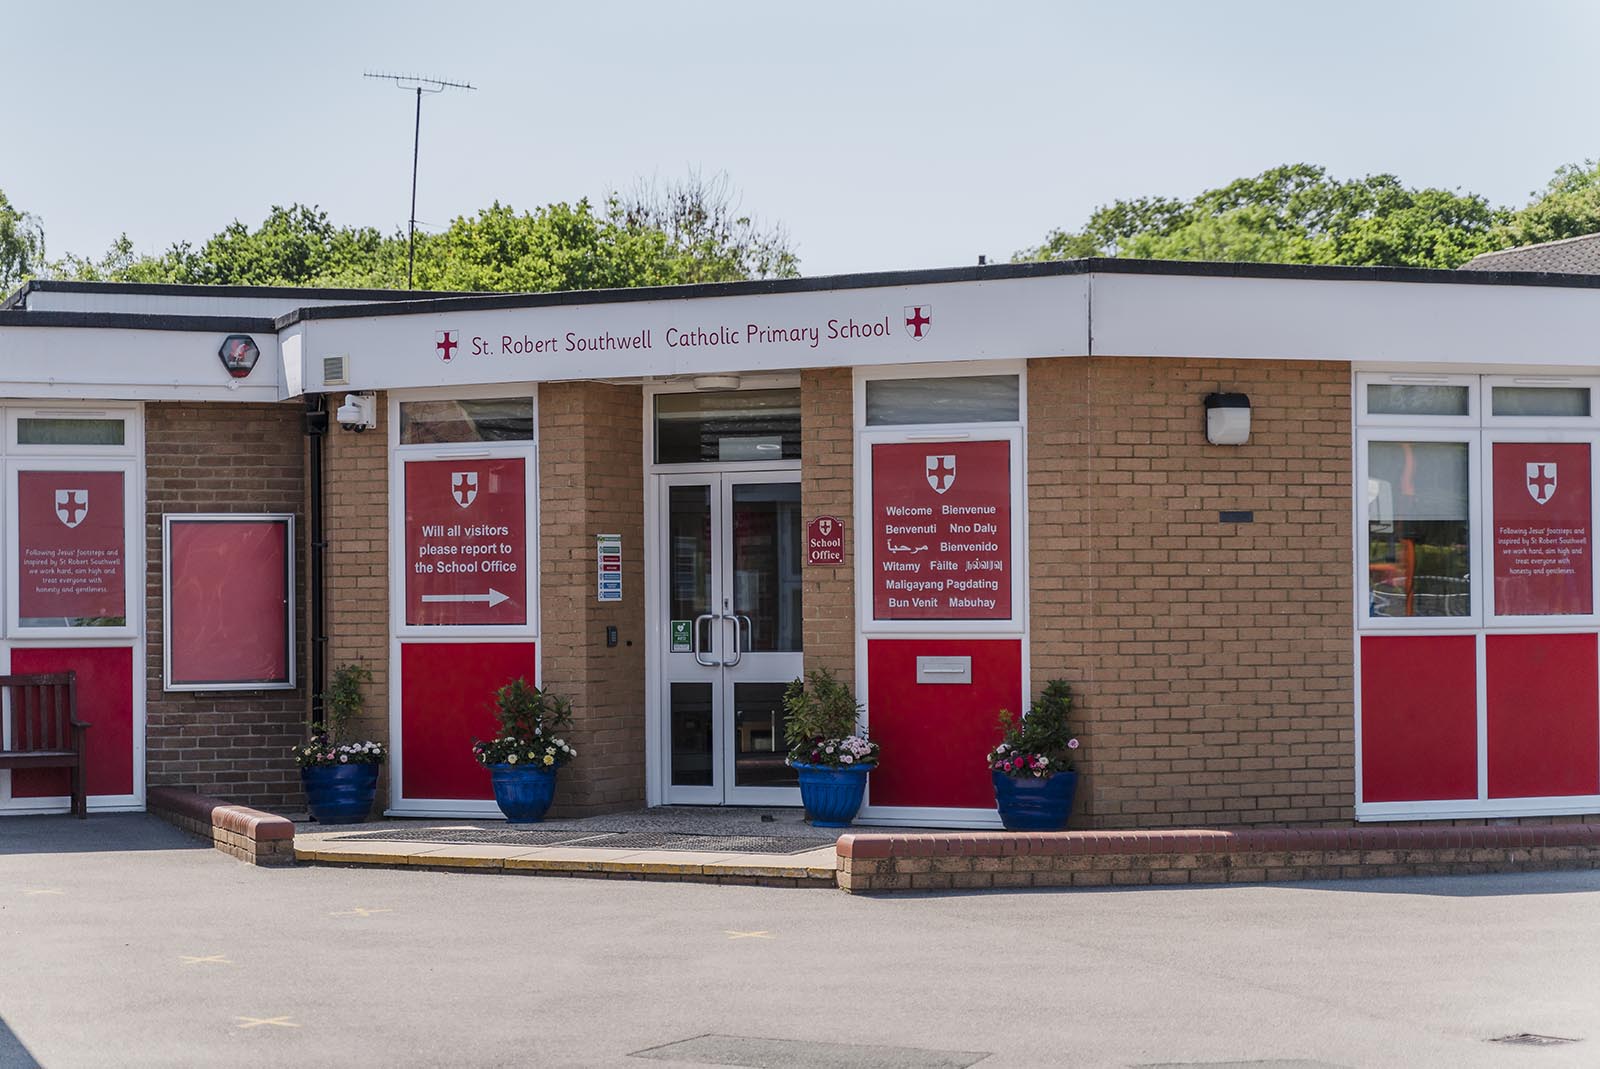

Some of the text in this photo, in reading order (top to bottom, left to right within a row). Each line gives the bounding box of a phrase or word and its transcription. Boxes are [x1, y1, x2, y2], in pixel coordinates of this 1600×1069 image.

[472, 316, 890, 355] St. Robert Southwell Catholic Primary School
[886, 505, 996, 516] Welcome Bienvenue
[422, 524, 509, 537] Will all visitors
[886, 524, 936, 534] Benvenuti
[950, 523, 971, 533] Nno
[811, 538, 840, 547] School
[940, 541, 998, 551] Bienvenido
[1522, 537, 1529, 546] by
[26, 549, 55, 557] Following
[77, 549, 105, 557] footsteps
[419, 543, 512, 557] please report to
[812, 551, 840, 559] Office
[88, 568, 102, 576] high
[415, 560, 517, 573] the School Office
[883, 561, 920, 573] Witamy
[886, 579, 998, 591] Maligayang Pagdating
[889, 597, 996, 609] Bun Venit Mabuhay
